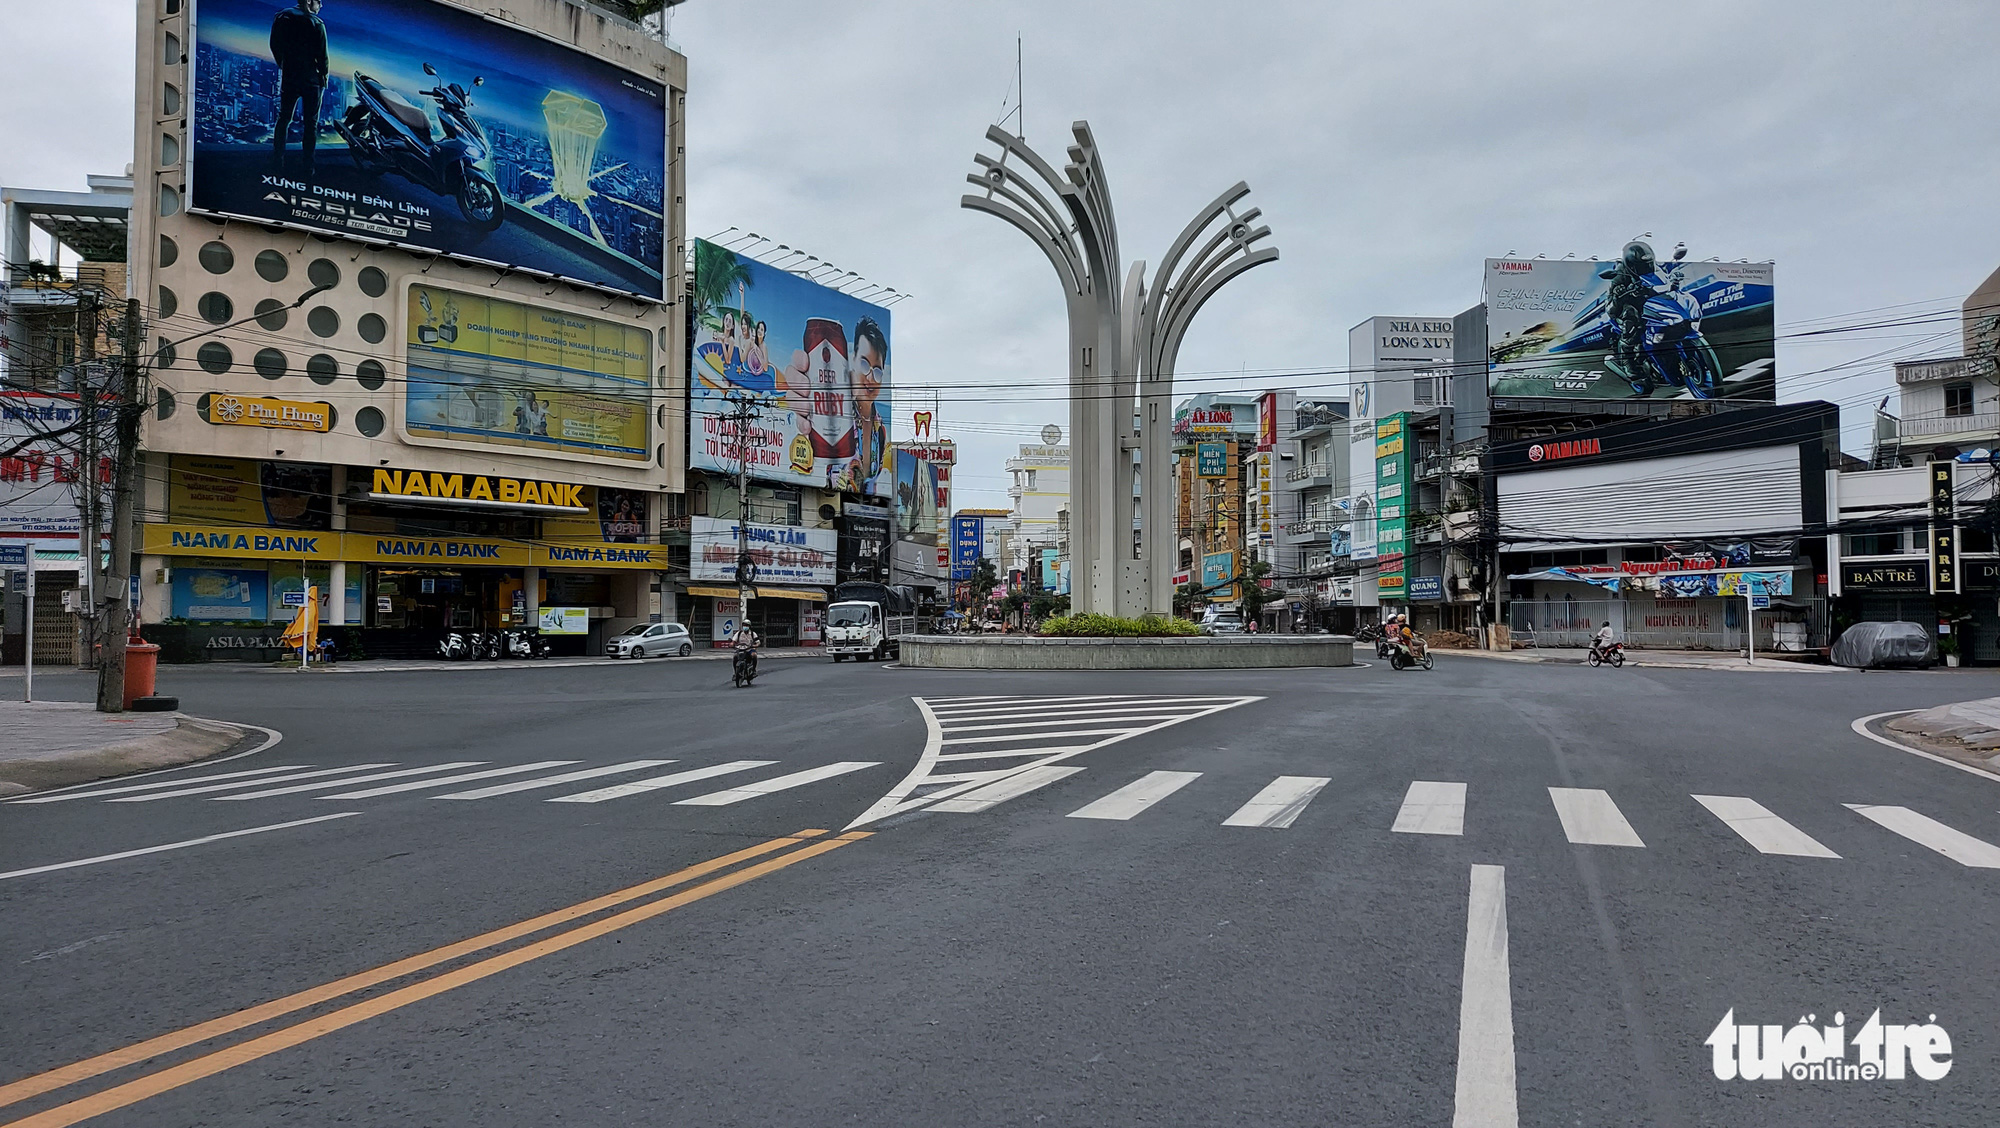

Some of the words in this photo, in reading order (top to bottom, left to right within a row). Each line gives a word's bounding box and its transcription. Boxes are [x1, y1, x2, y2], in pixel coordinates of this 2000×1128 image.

[262, 175, 306, 192] XƯNG
[313, 186, 356, 201] DANH
[399, 202, 430, 216] LĨNH
[1501, 262, 1532, 271] YAMAHA
[1720, 290, 1745, 305] LEVEL
[1390, 322, 1420, 332] NHA
[467, 323, 493, 334] DOANH
[569, 342, 590, 350] NHANH
[1382, 336, 1419, 348] LONG
[819, 368, 836, 384] BEER
[1558, 370, 1605, 380] 155
[814, 392, 844, 416] RUBY
[248, 404, 277, 419] Phu
[281, 406, 324, 428] Hung
[1209, 411, 1232, 423] LONG
[703, 415, 716, 434] TÔI
[705, 437, 718, 456] TÔI
[761, 449, 781, 467] RUBY
[931, 447, 952, 460] TÂM
[1544, 438, 1602, 460] YAMAHA
[372, 469, 463, 499] NAM
[467, 476, 494, 500] A
[499, 478, 584, 508] BANK
[778, 528, 807, 545] TÂM
[964, 529, 974, 537] TÍN
[172, 531, 230, 549] NAM
[233, 534, 250, 549] A
[254, 535, 318, 552] BANK
[376, 540, 425, 556] NAM
[428, 542, 442, 557] A
[446, 543, 500, 558] BANK
[549, 547, 588, 560] NAM
[592, 548, 604, 561] A
[606, 549, 651, 562] BANK
[1620, 557, 1680, 575] Nguyễn
[1682, 557, 1717, 571] Huệ
[1720, 556, 1729, 568] 1
[1854, 573, 1884, 585] BẠN
[1887, 568, 1916, 582] TRẺ
[1410, 582, 1438, 591] QUANG
[718, 600, 738, 613] OPTIC
[206, 636, 245, 648] ASIA
[249, 636, 288, 649] PLAZ
